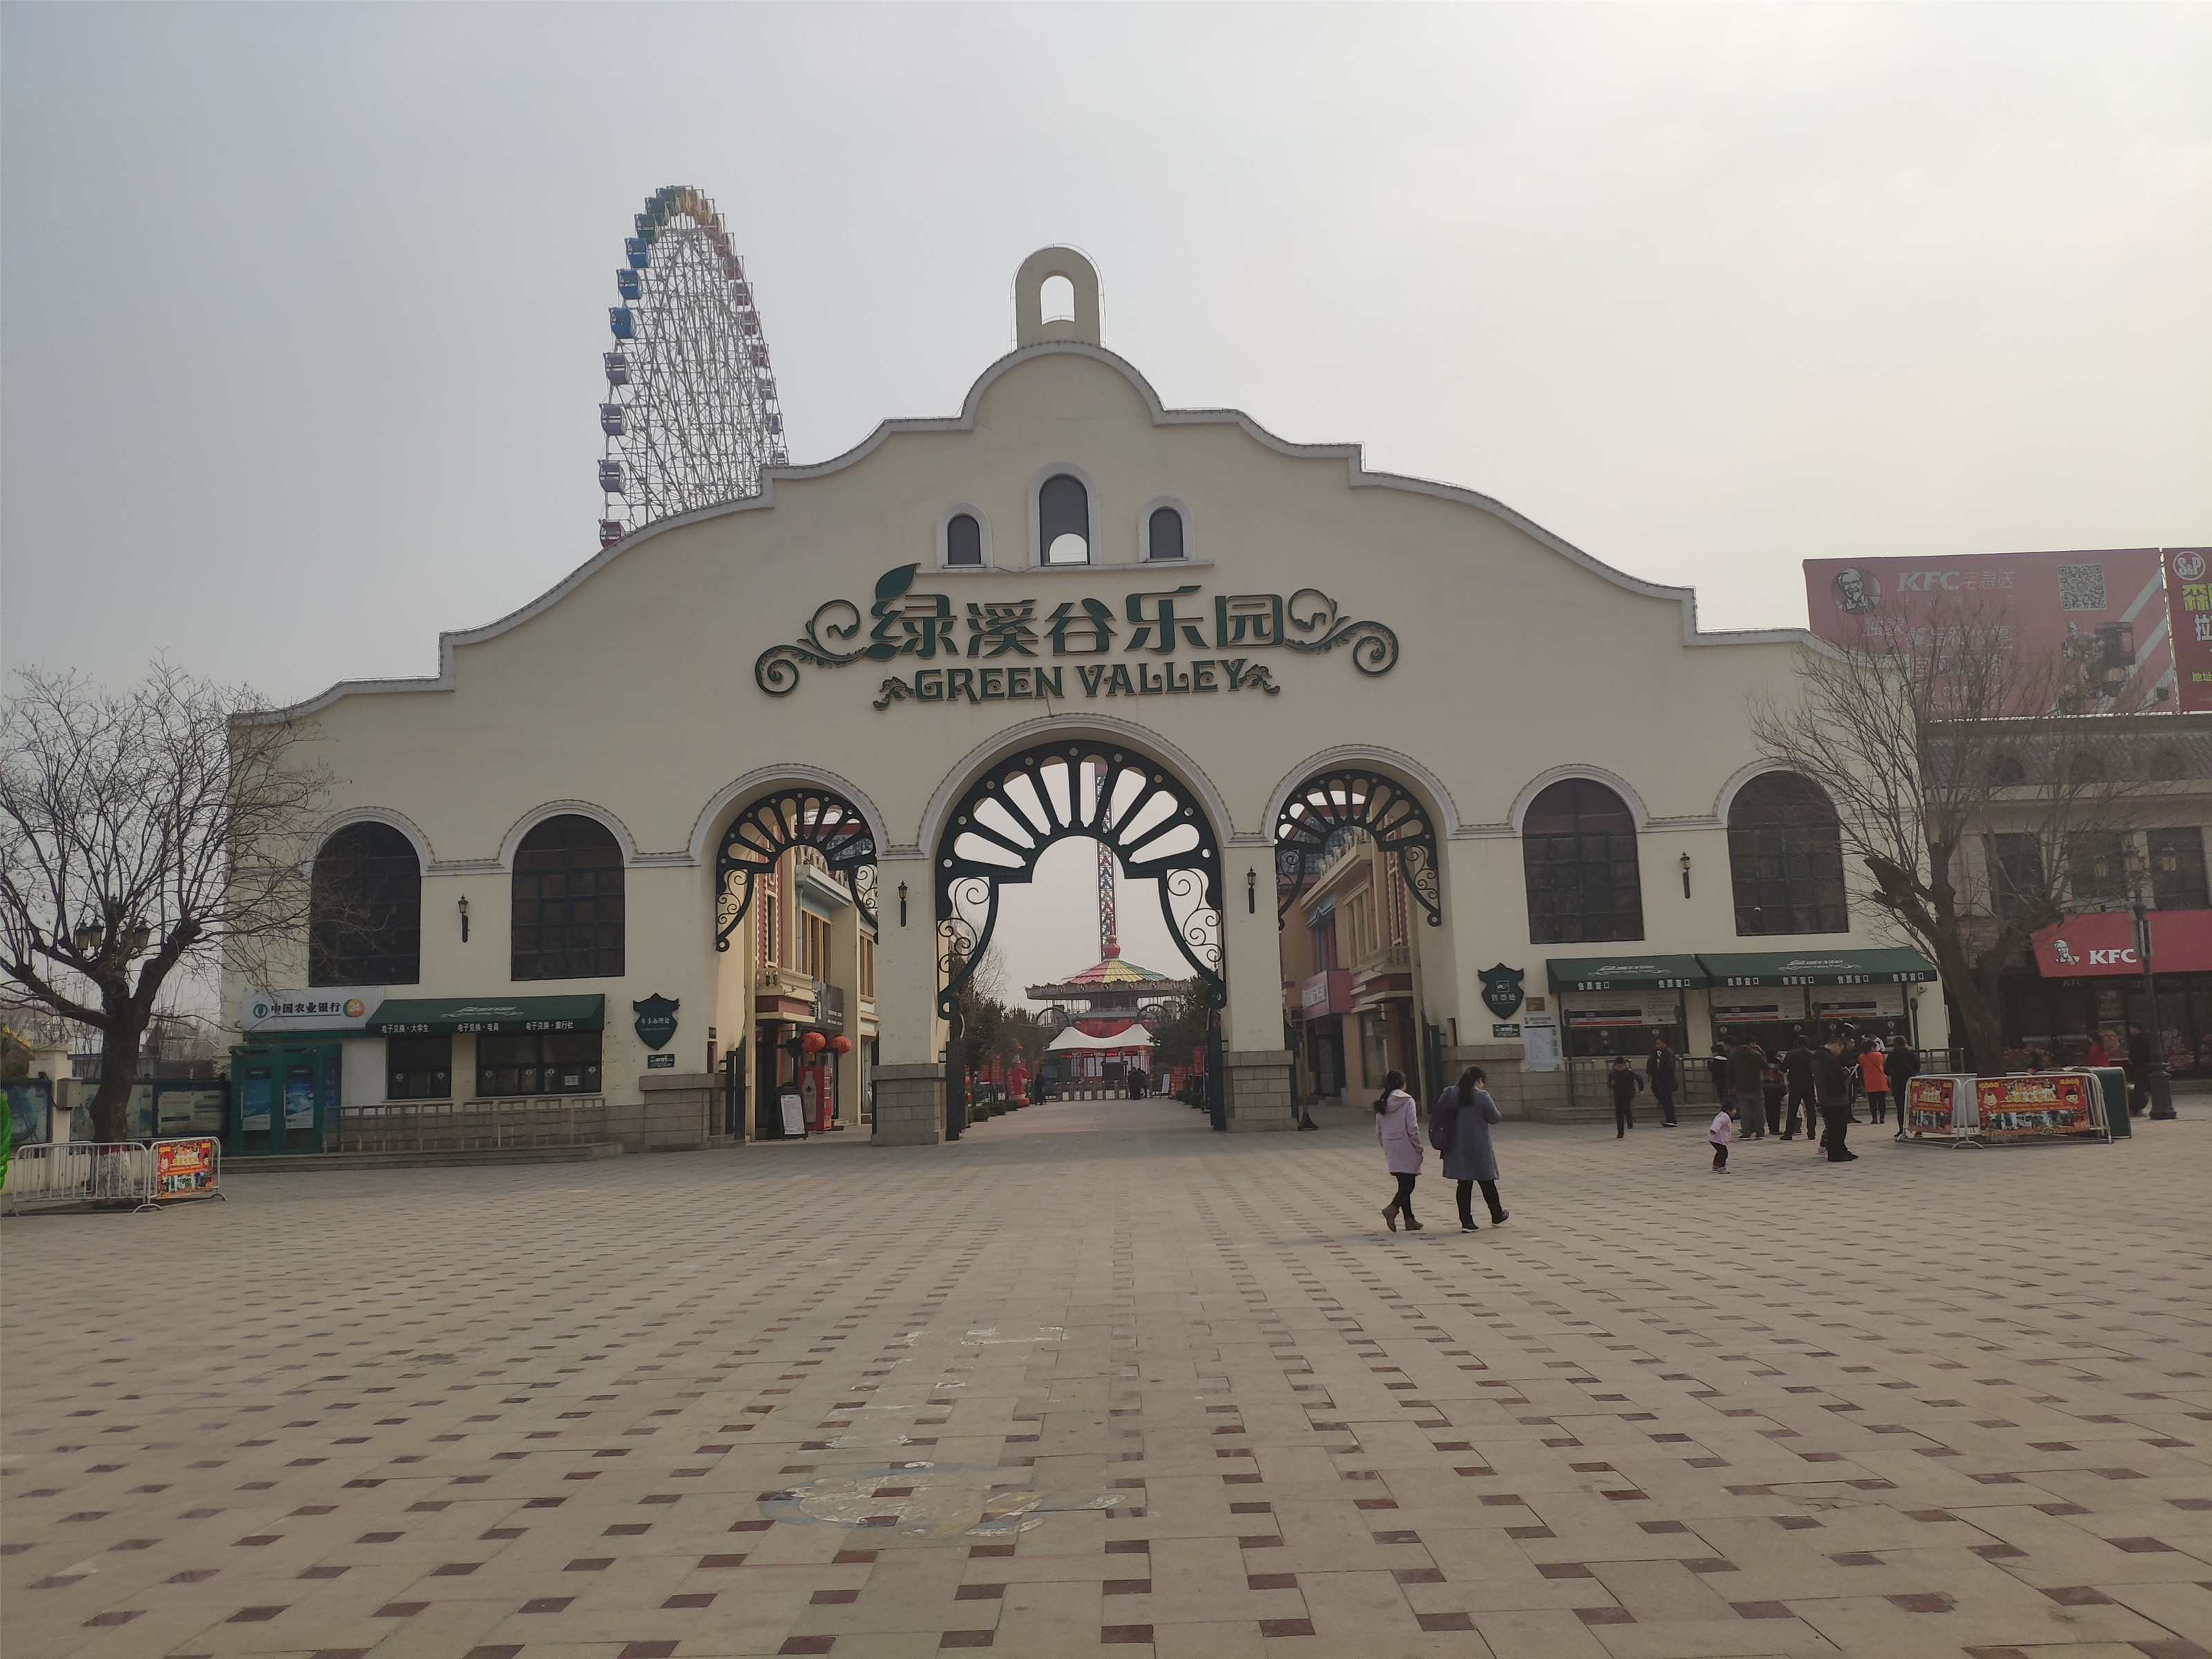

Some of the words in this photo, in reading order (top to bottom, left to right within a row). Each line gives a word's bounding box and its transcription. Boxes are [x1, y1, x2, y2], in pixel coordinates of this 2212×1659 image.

[2177, 556, 2202, 576] S&P
[1896, 571, 1960, 592] KFC
[1963, 570, 2015, 590] 宅急送
[2182, 583, 2212, 611] 森
[864, 582, 1284, 659] 绿溪谷乐园
[1864, 617, 1905, 637] 独家
[2195, 614, 2212, 641] 拉
[914, 665, 1065, 704] GREEN
[1074, 659, 1248, 697] VALLEY
[2088, 948, 2137, 964] KFC
[270, 1002, 341, 1015] 中国农业银行
[641, 1017, 671, 1025] 年卡办理处
